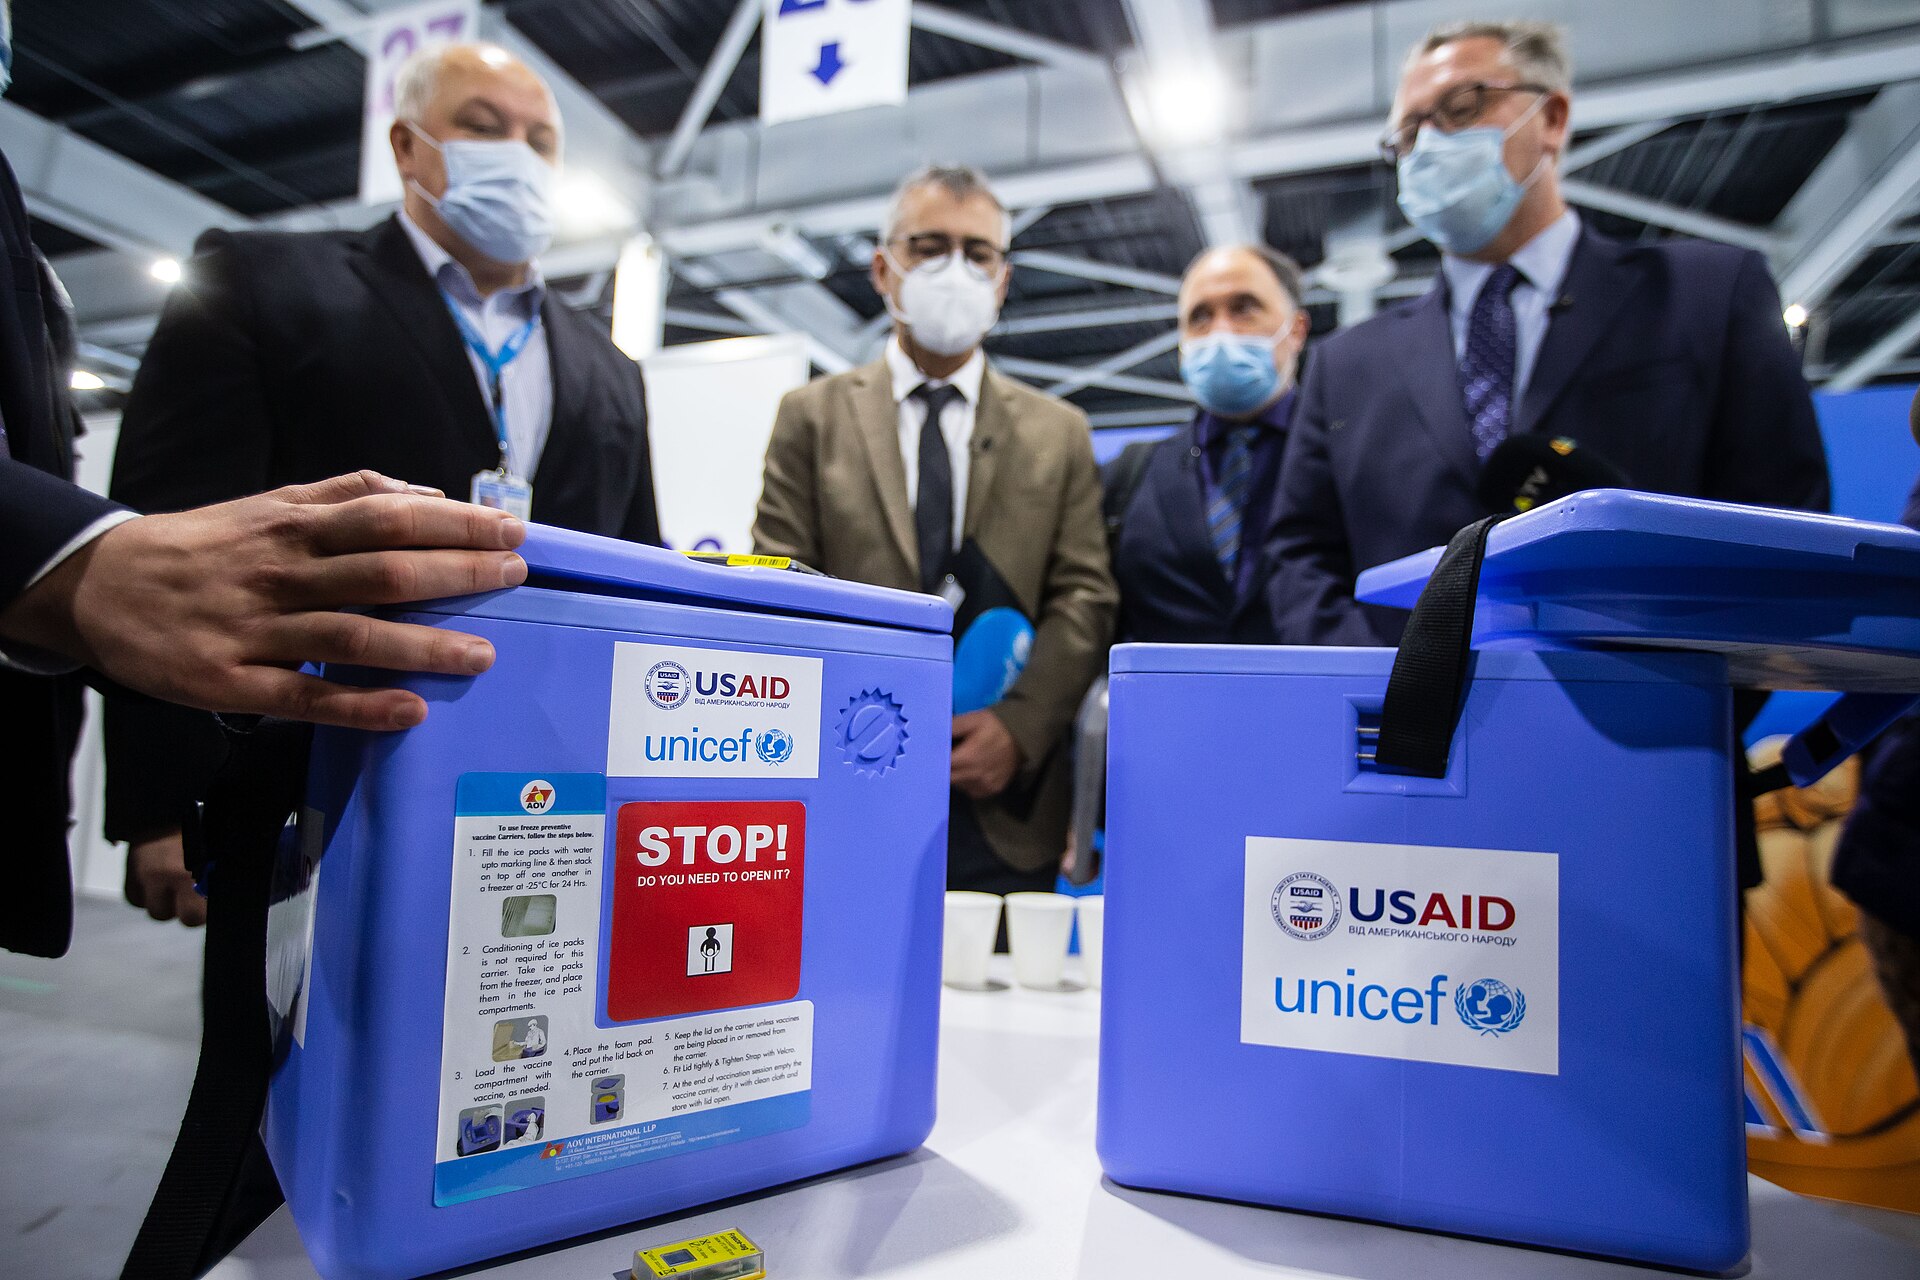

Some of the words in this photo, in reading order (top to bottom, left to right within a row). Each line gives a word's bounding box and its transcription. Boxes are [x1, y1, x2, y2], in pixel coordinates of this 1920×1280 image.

[695, 672, 790, 700] USAID
[706, 699, 765, 708] АМЕРИКАНСЬКОГО
[645, 727, 752, 763] unicef
[541, 824, 571, 832] preventive
[482, 849, 493, 857] Fill
[529, 848, 550, 857] packs
[637, 825, 788, 867] STOP!
[482, 861, 499, 870] upto
[501, 860, 531, 869] marking
[534, 859, 547, 867] line
[549, 858, 555, 866] &
[558, 857, 572, 865] then
[575, 857, 592, 865] stack
[498, 872, 509, 881] top
[516, 870, 526, 879] off
[638, 876, 656, 887] DO
[660, 874, 685, 886] YOU
[688, 872, 720, 885] NEED
[723, 872, 738, 883] TO
[741, 870, 771, 882] OPEN
[774, 869, 790, 880] IT?
[488, 883, 513, 892] freezer
[549, 880, 560, 889] for
[562, 880, 571, 888] 24
[1349, 887, 1516, 932] USAID
[1349, 925, 1366, 936] ВІД
[1368, 927, 1469, 943] АМЕРИКАНСЬКОГО
[1472, 935, 1517, 947] НАРОДУ
[482, 943, 533, 954] Conditioning
[537, 940, 546, 949] of
[549, 940, 560, 948] ice
[563, 938, 585, 948] packs
[496, 957, 508, 965] not
[515, 954, 547, 964] required
[554, 952, 565, 960] for
[572, 950, 584, 958] this
[481, 970, 510, 979] carrier.
[518, 967, 536, 975] Take
[562, 962, 584, 972] packs
[480, 982, 499, 991] from
[501, 980, 513, 989] the
[515, 978, 543, 988] freezer,
[546, 976, 561, 984] and
[563, 974, 583, 984] place
[479, 994, 500, 1003] them
[524, 990, 537, 998] the
[545, 988, 556, 996] ice
[563, 985, 583, 995] pack
[1275, 968, 1448, 1026] unicef
[479, 1003, 536, 1016] compartments.
[674, 1032, 691, 1042] Keep
[693, 1028, 703, 1037] the
[704, 1027, 713, 1035] lid
[724, 1024, 734, 1032] the
[735, 1022, 755, 1031] carrier
[757, 1019, 774, 1028] unless
[776, 1015, 800, 1025] vaccines
[573, 1047, 592, 1055] Place
[598, 1043, 609, 1052] the
[615, 1041, 633, 1049] foam
[638, 1036, 654, 1047] pad.
[687, 1039, 705, 1050] being
[707, 1035, 728, 1047] placed
[746, 1028, 771, 1039] removed
[772, 1027, 786, 1035] from
[572, 1058, 587, 1068] and
[589, 1057, 601, 1066] put
[603, 1054, 614, 1063] the
[615, 1053, 624, 1061] lid
[626, 1049, 643, 1058] back
[674, 1054, 684, 1062] the
[686, 1051, 707, 1060] carrier.
[683, 1063, 692, 1072] Lid
[694, 1060, 712, 1071] tightly
[722, 1055, 744, 1066] Tighten
[746, 1053, 761, 1061] Strap
[763, 1049, 775, 1057] with
[475, 1067, 496, 1078] Load
[503, 1064, 516, 1073] the
[523, 1061, 553, 1070] vaccine
[572, 1070, 583, 1079] the
[585, 1067, 610, 1077] carrier.
[694, 1076, 706, 1085] end
[708, 1074, 714, 1082] of
[716, 1069, 750, 1081] vaccination
[752, 1066, 773, 1075] session
[774, 1062, 792, 1070] empty
[474, 1076, 528, 1091] compartment
[536, 1071, 552, 1080] with
[672, 1091, 697, 1100] vaccine
[698, 1086, 719, 1096] carrier,
[722, 1083, 733, 1092] dry
[740, 1079, 753, 1087] with
[754, 1077, 770, 1085] clean
[772, 1072, 785, 1081] cloth
[787, 1070, 798, 1078] and
[473, 1091, 506, 1102] vaccine,
[508, 1089, 518, 1097] as
[520, 1084, 551, 1095] needed.
[672, 1104, 687, 1112] store
[689, 1099, 702, 1108] with
[704, 1097, 712, 1105] lid
[567, 1139, 584, 1149] AOV
[586, 1128, 641, 1145] INTERNATIONAL
[643, 1124, 657, 1133] LLP
